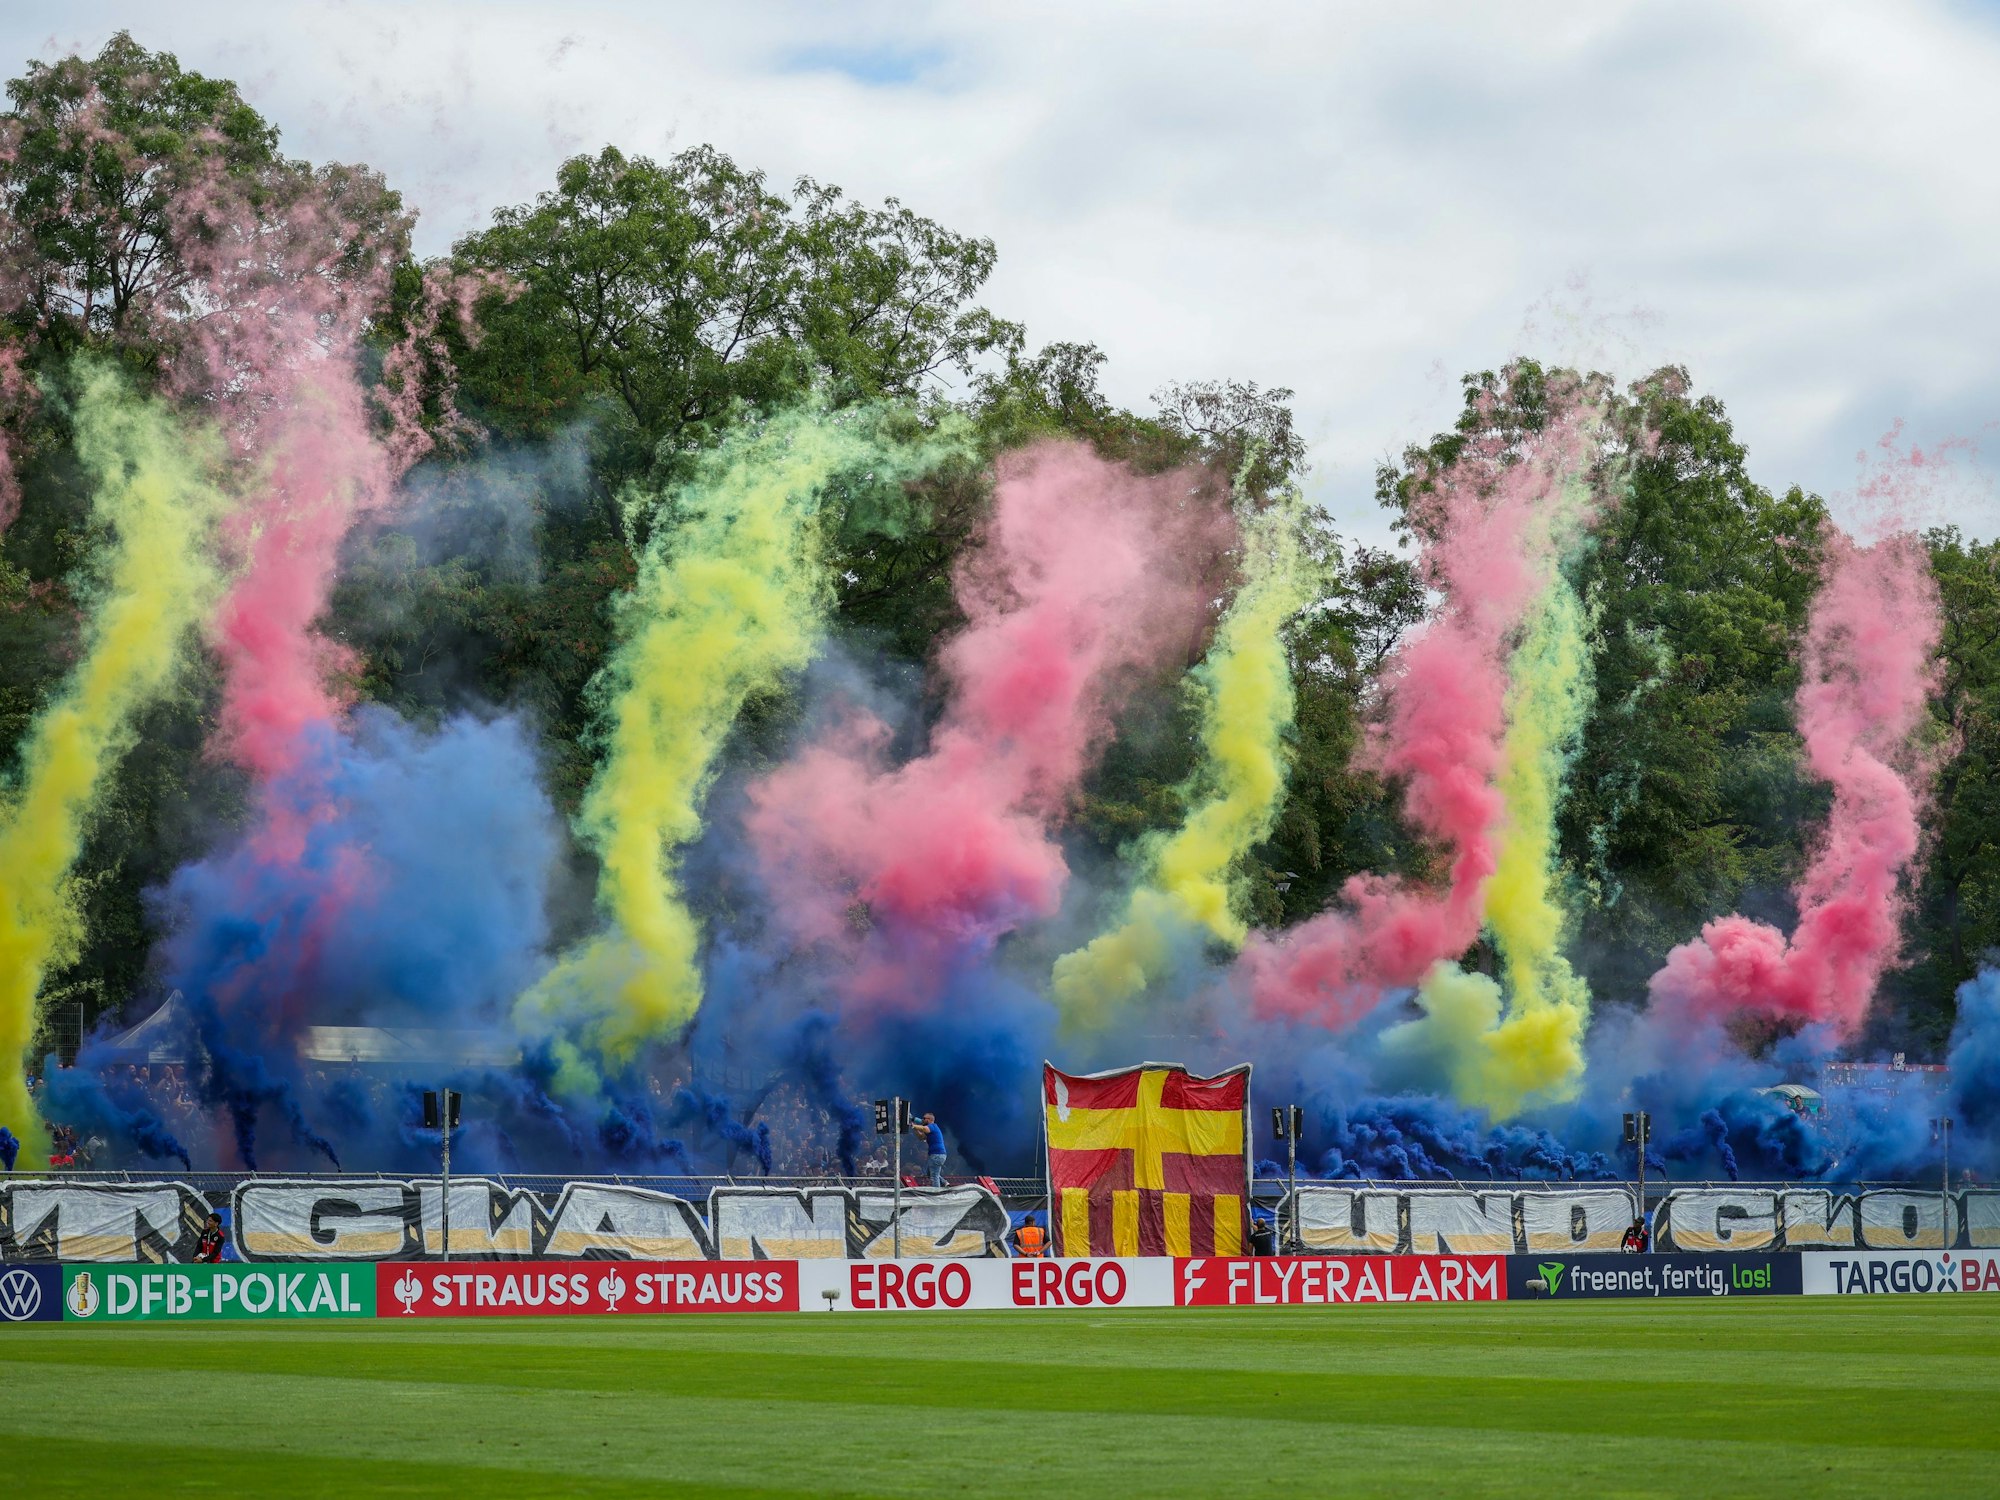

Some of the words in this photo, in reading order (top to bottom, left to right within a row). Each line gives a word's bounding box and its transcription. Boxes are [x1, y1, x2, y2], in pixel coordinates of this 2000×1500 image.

[1298, 1190, 1638, 1254] UND
[106, 1272, 361, 1315] DFB-POKAL
[432, 1273, 590, 1307] STRAUSS
[634, 1271, 784, 1305] STRAUSS
[850, 1262, 972, 1309] ERGO
[1012, 1261, 1128, 1307] ERGO
[1228, 1257, 1498, 1305] FLYERALARM
[1570, 1265, 1661, 1297] freenet,
[1662, 1263, 1730, 1297] fertig,
[1732, 1263, 1771, 1289] los!
